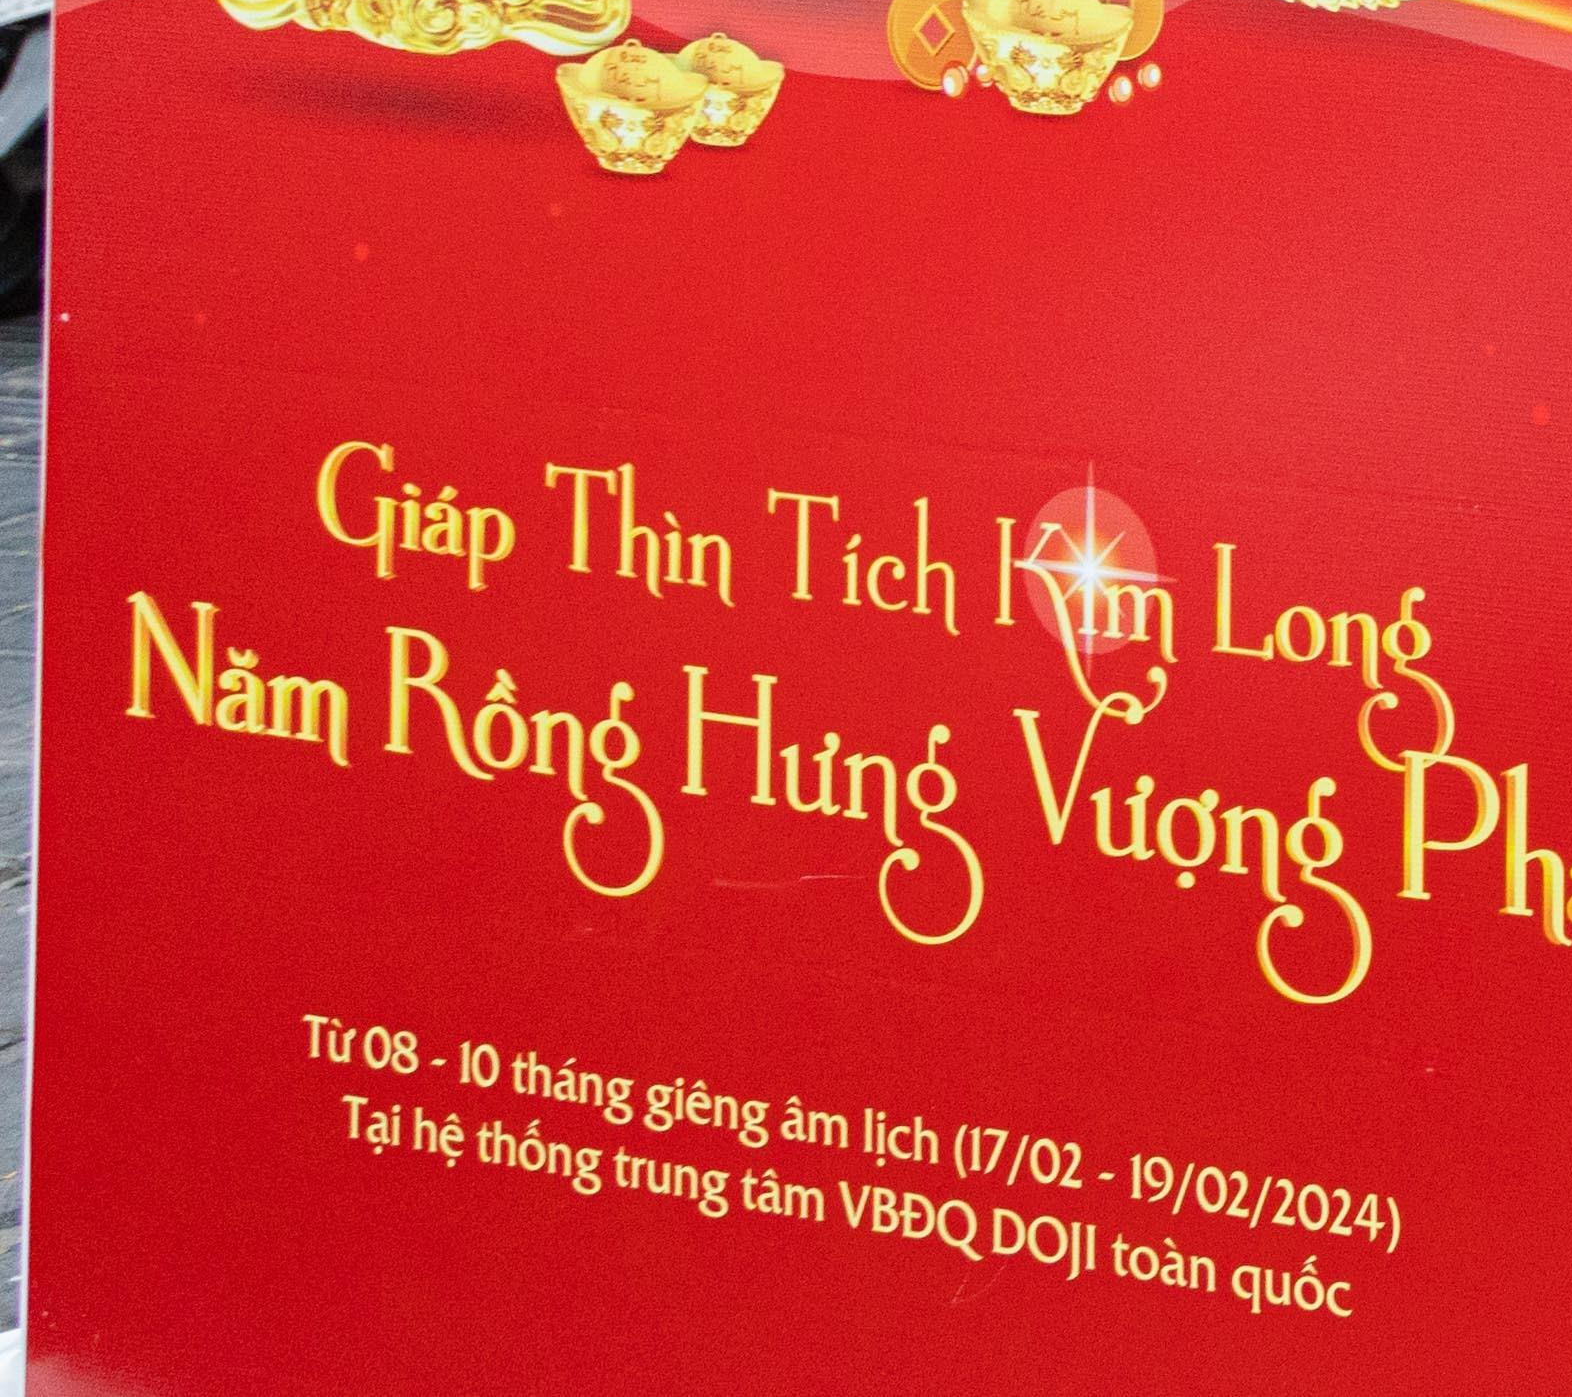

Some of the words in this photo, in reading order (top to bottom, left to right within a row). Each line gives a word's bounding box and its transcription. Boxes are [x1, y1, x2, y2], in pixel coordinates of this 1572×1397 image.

[312, 438, 517, 592] Giáp
[544, 461, 735, 607] Thìn
[766, 486, 961, 637] Tích
[995, 514, 1180, 723] Kim
[1211, 541, 1456, 773] Long
[125, 590, 351, 770] Năm
[383, 626, 665, 899] Rồng
[680, 664, 985, 946] Hưng
[1012, 694, 1374, 1005] Vượng
[301, 1012, 356, 1068] Từ
[361, 1024, 420, 1074] 08
[458, 1040, 501, 1088] 10
[511, 1049, 635, 1126] tháng
[644, 1073, 769, 1149] giêng
[780, 1092, 851, 1150] âm
[861, 1106, 941, 1167] lịch
[952, 1122, 1084, 1192] (17/02
[1128, 1148, 1403, 1253] 19/02/2024)
[341, 1092, 401, 1152] Tại
[413, 1109, 465, 1171] hệ
[476, 1120, 603, 1195] thống
[613, 1146, 729, 1218] trung
[739, 1164, 826, 1224] tâm
[838, 1183, 985, 1266] VBĐQ
[991, 1207, 1098, 1283] DOJI
[1110, 1230, 1217, 1295] toàn
[1231, 1247, 1356, 1319] quốc
